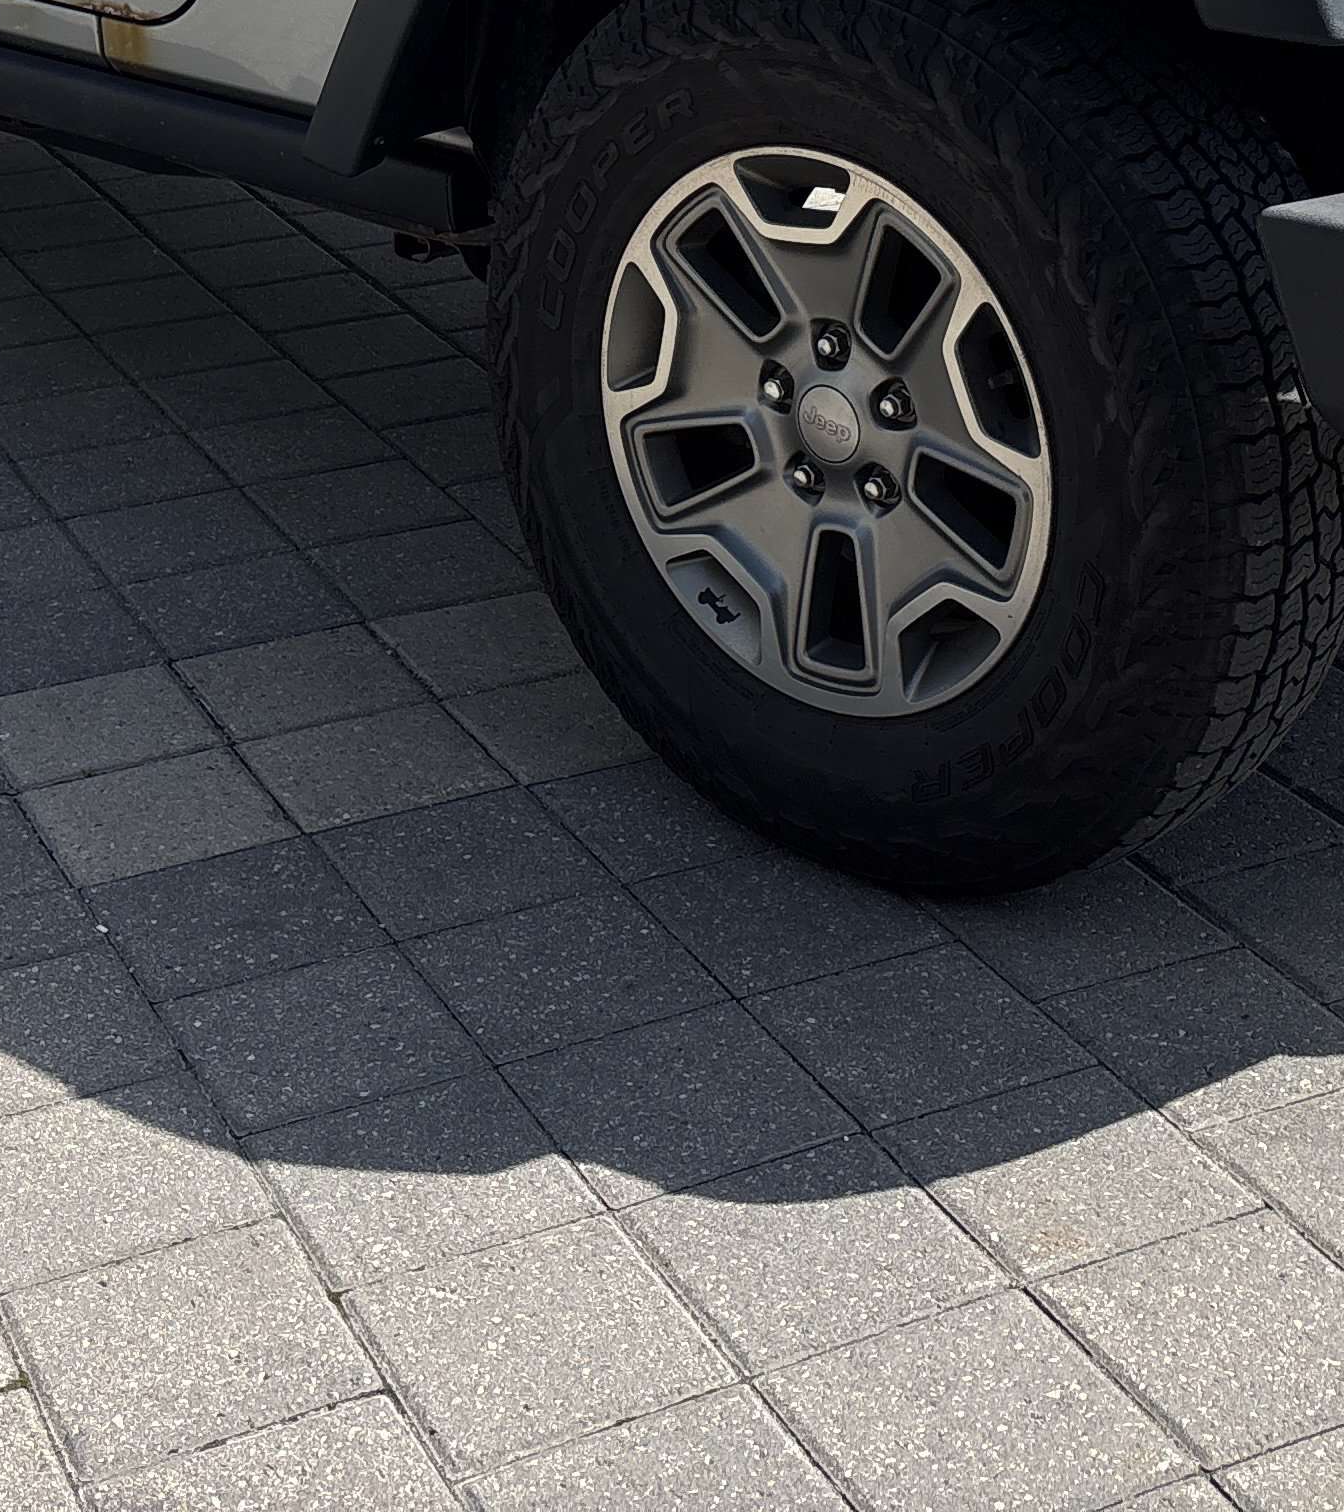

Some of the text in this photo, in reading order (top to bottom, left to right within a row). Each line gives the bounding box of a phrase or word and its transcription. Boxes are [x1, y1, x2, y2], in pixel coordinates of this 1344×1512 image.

[539, 88, 697, 330] COOPER
[803, 406, 851, 443] Jeep
[910, 560, 1105, 803] COOPER
